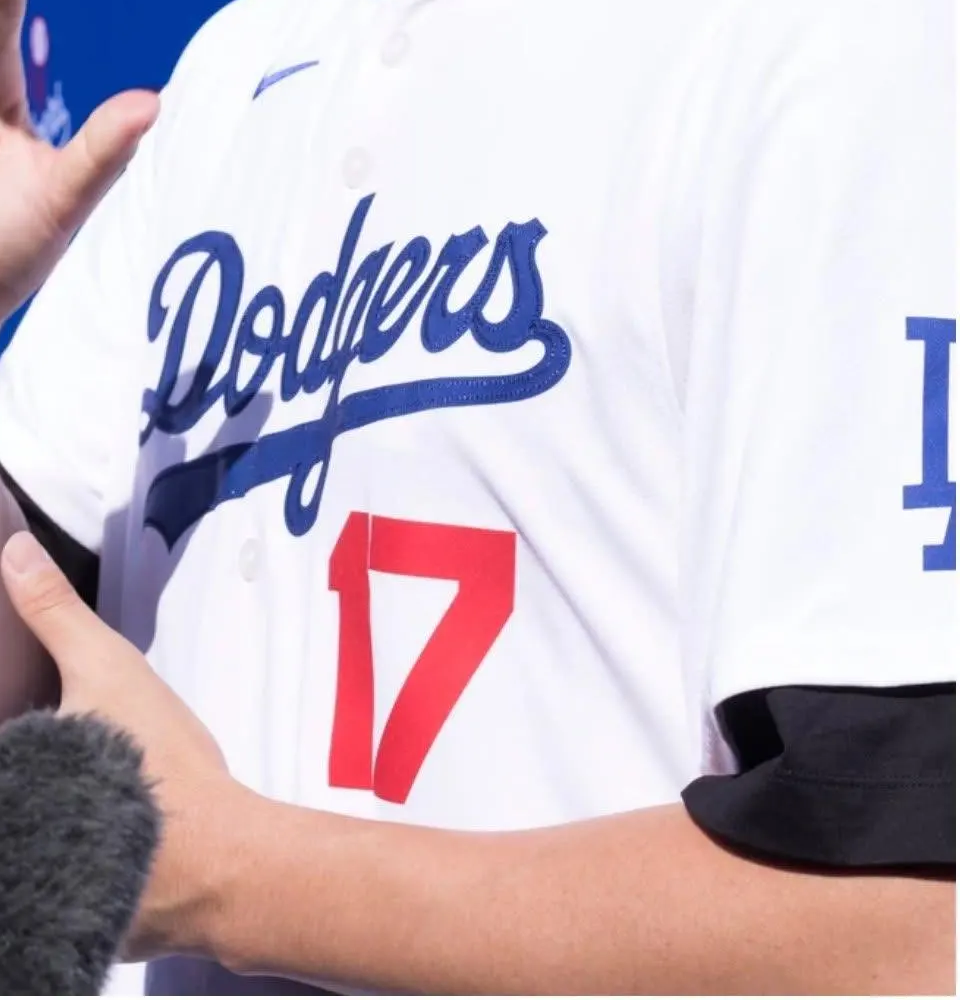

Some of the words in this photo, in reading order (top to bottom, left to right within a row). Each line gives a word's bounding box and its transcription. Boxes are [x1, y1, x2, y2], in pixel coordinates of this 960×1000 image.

[139, 193, 571, 548] Dodgers
[902, 315, 956, 572] L
[328, 511, 517, 805] 17
